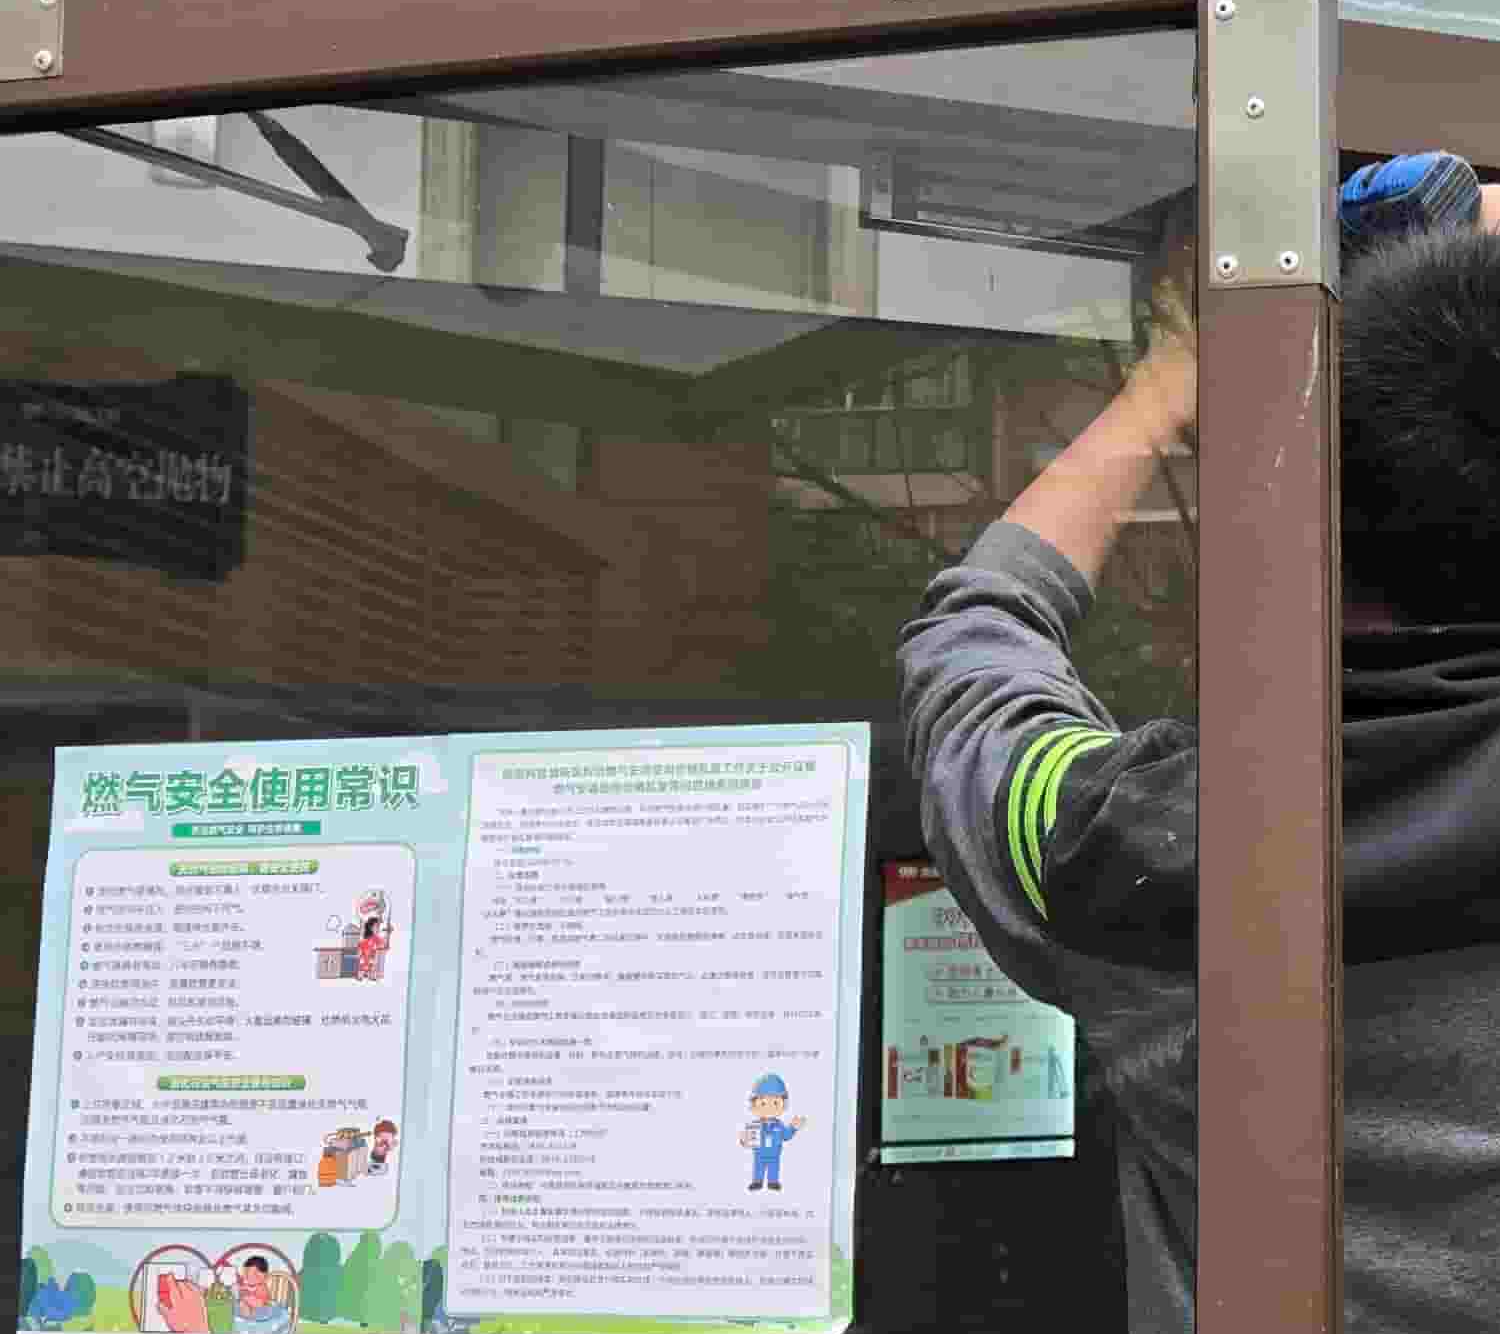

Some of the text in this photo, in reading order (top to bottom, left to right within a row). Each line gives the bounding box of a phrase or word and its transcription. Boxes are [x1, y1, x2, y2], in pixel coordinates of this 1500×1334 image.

[80, 763, 422, 817] 燃气安全使用常识
